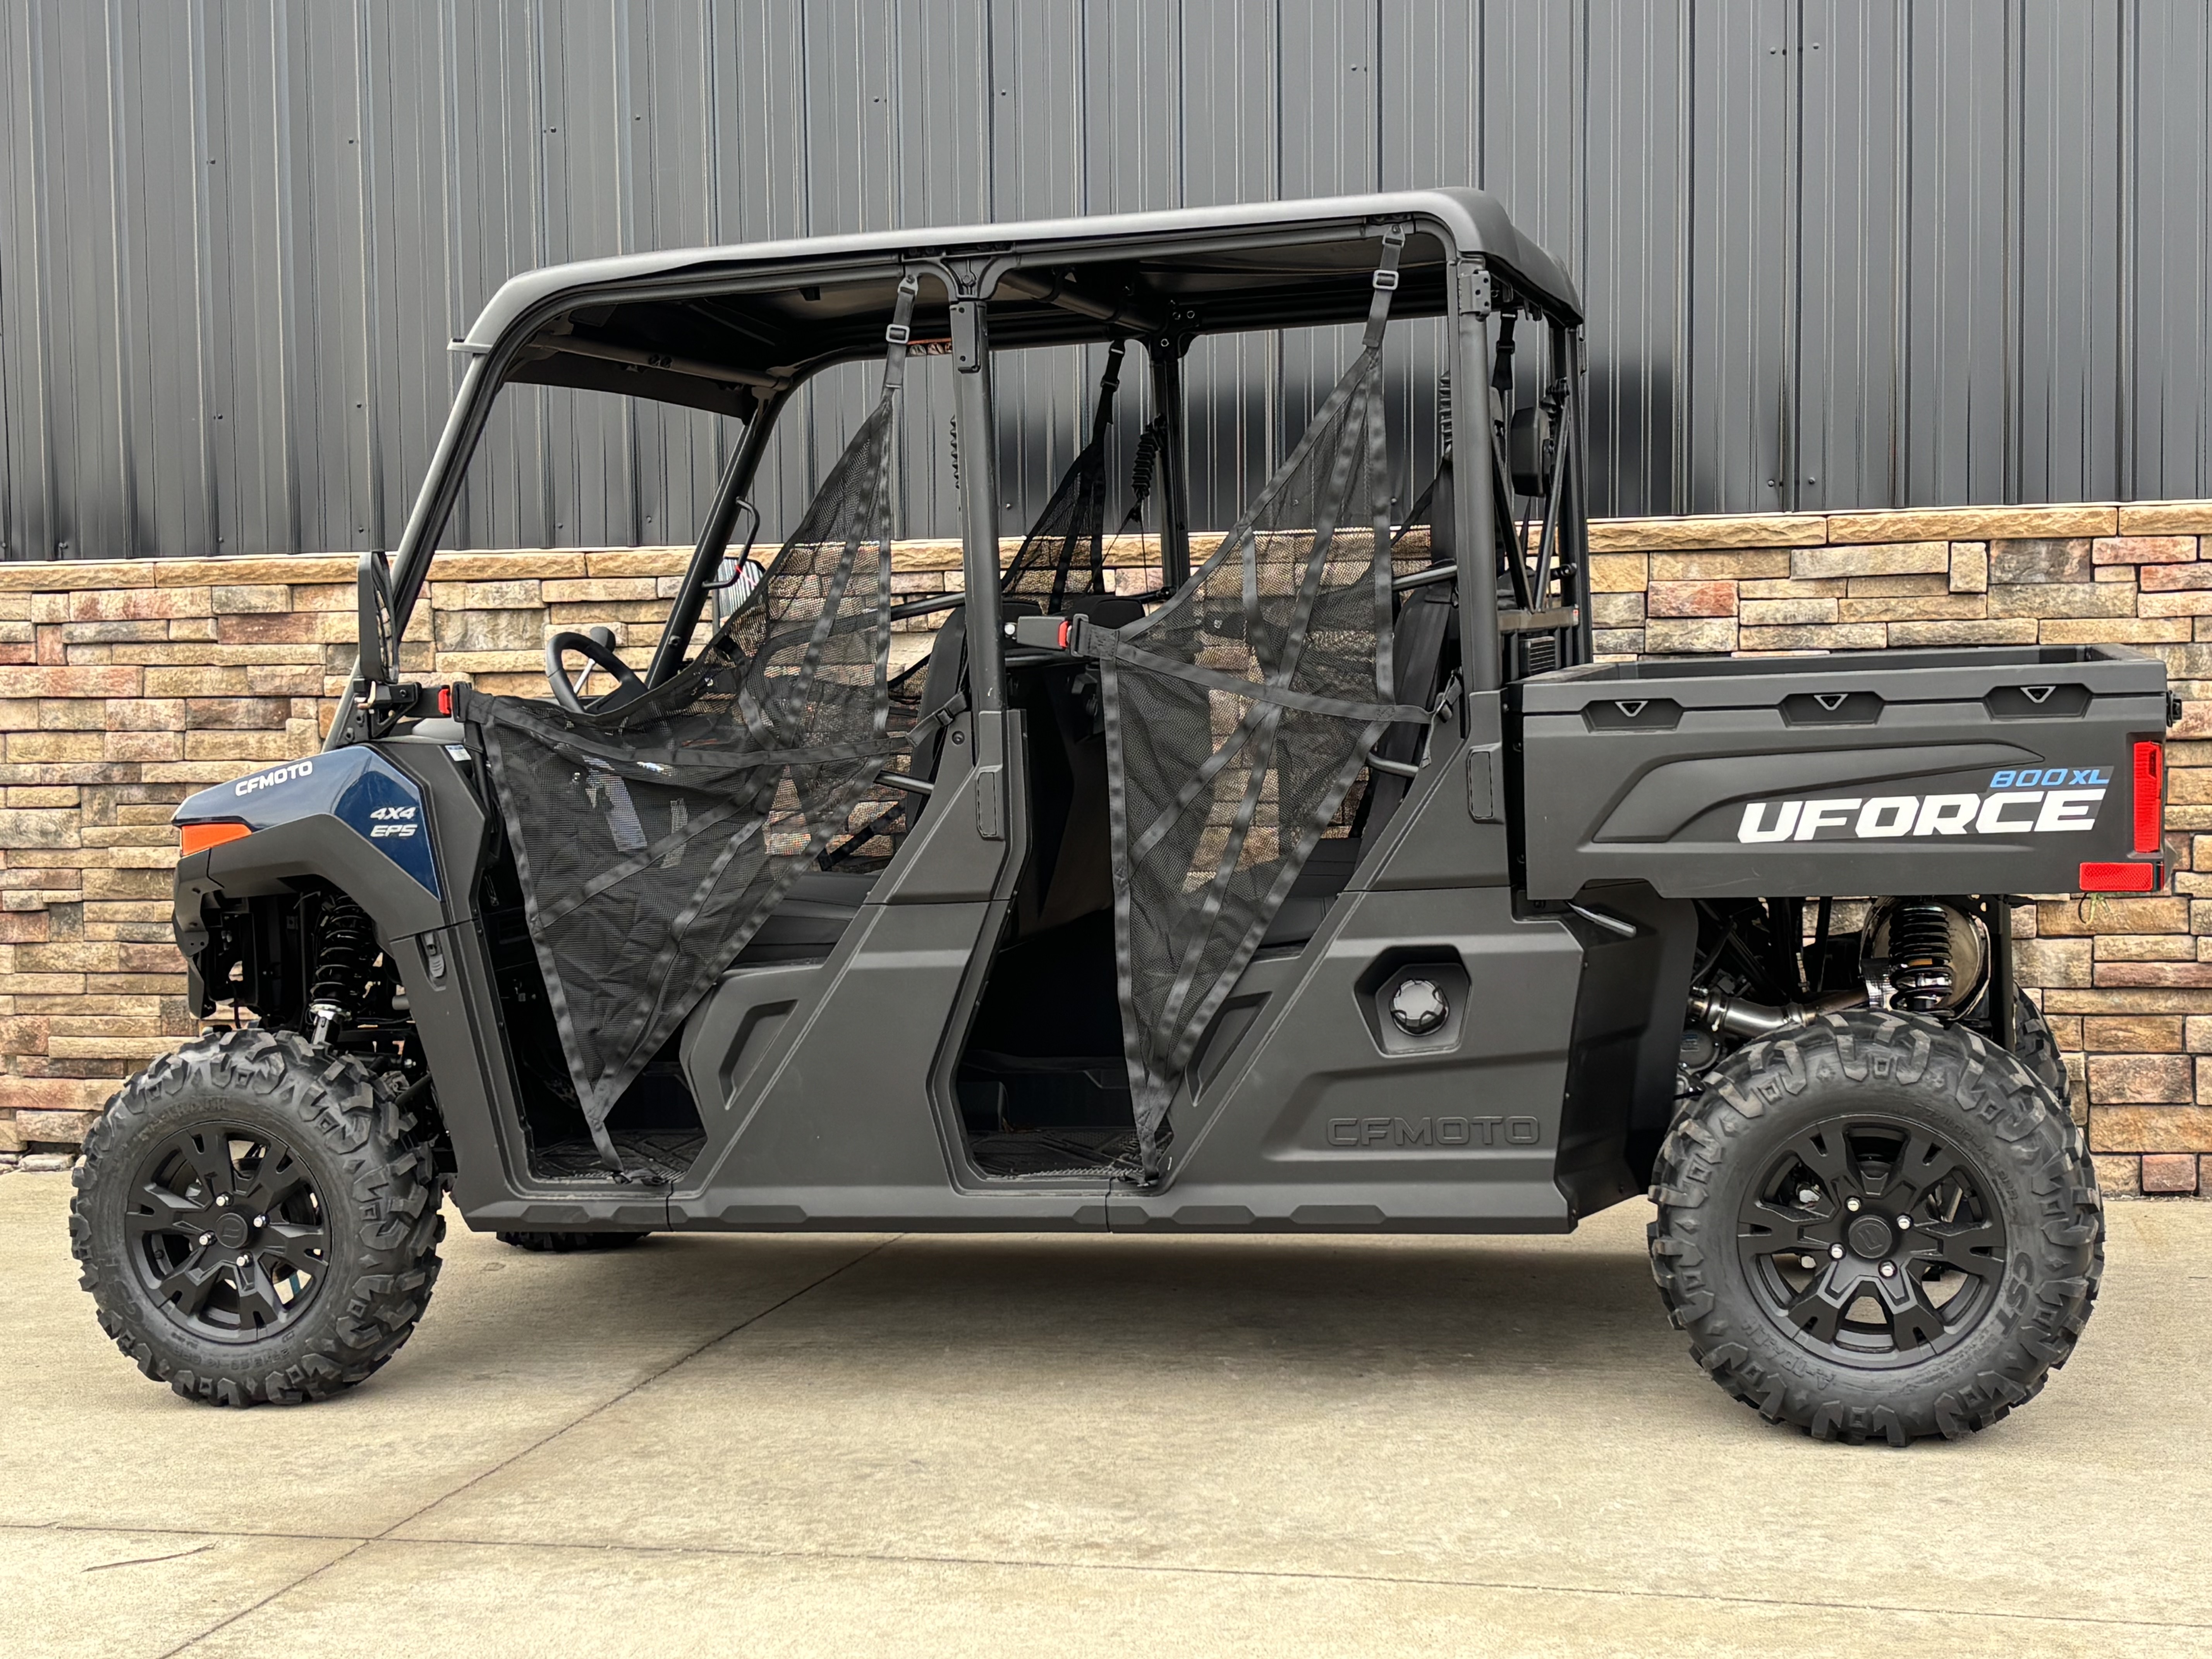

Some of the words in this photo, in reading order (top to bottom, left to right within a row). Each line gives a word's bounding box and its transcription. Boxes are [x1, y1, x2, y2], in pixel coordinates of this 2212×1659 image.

[235, 761, 313, 796] CFMOTO
[1990, 769, 2068, 787] 800
[370, 807, 416, 820] 4X4
[1737, 788, 2106, 843] UFORCE
[370, 824, 417, 837] EPS
[1327, 1116, 1540, 1146] CFMOTO
[1996, 1252, 2038, 1338] CST
